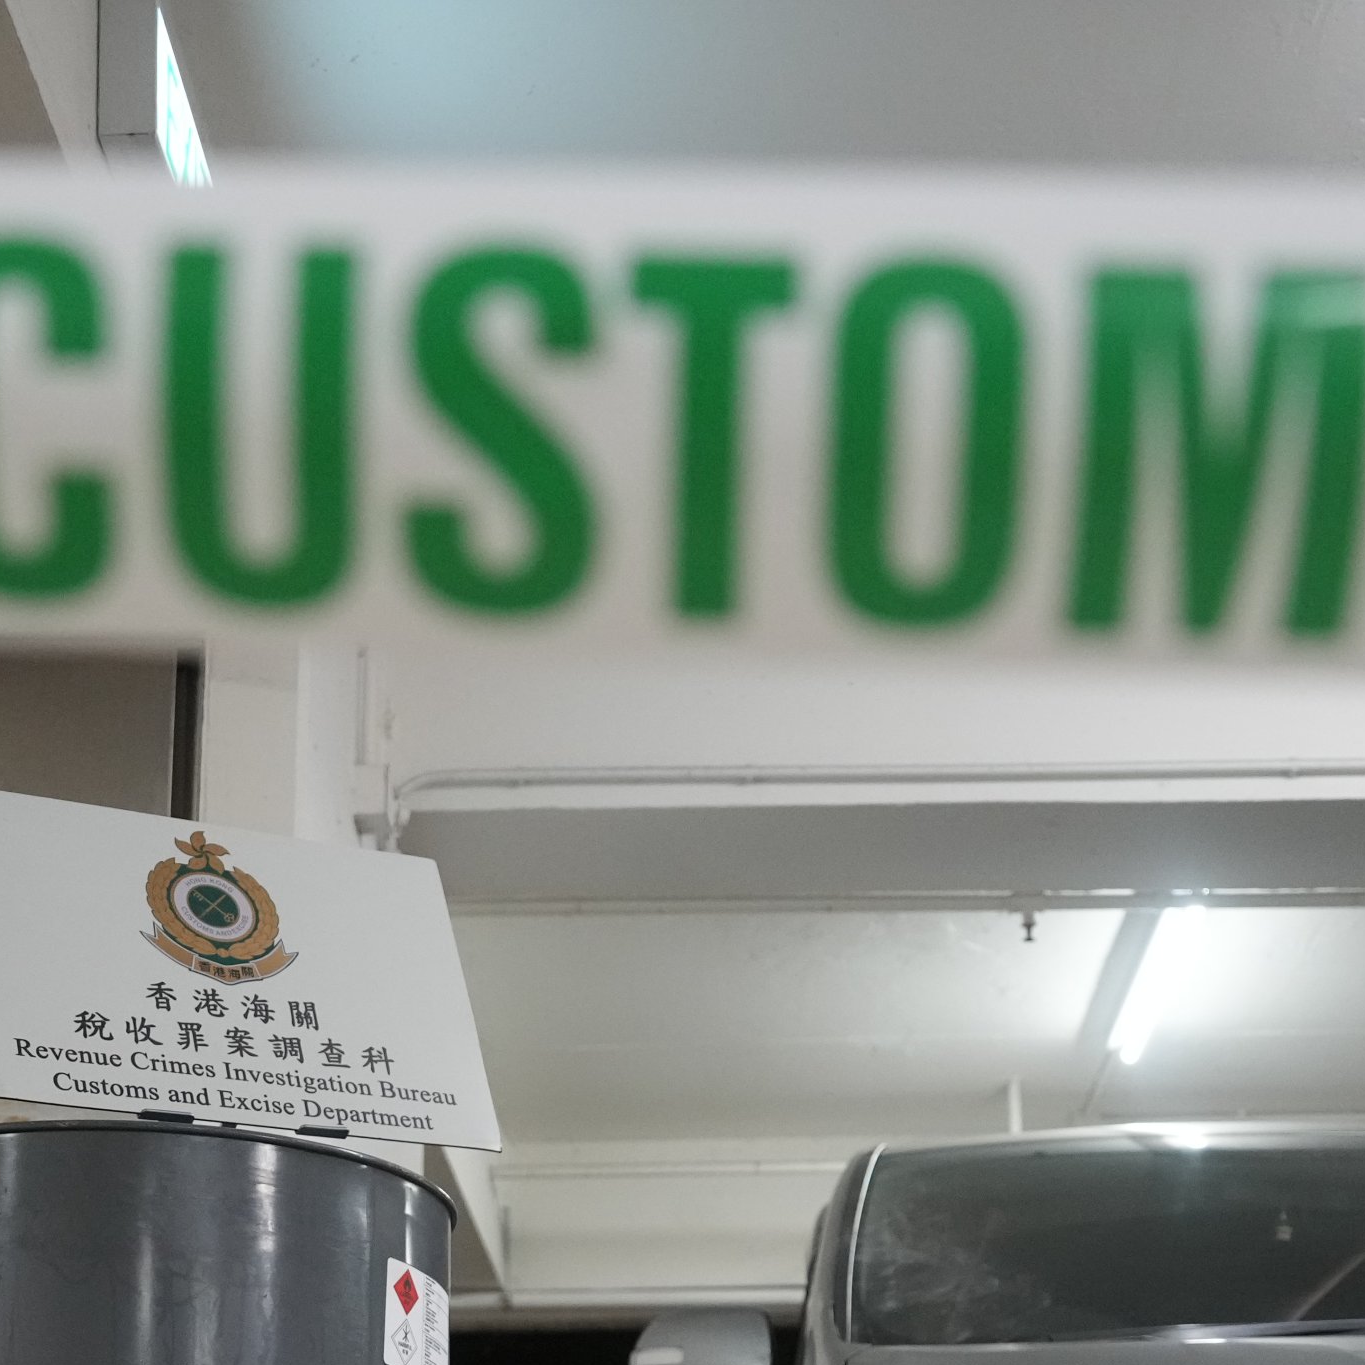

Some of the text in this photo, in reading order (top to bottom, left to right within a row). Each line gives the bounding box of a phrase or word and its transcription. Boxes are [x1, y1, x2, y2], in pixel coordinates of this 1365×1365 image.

[186, 877, 235, 894] HONG KONG
[181, 906, 215, 935] CUSTOMS
[198, 960, 255, 979] 香港海關
[145, 981, 320, 1031] 香港海關
[73, 1010, 395, 1076] 稅收罪案調查科
[13, 1038, 458, 1106] Revenue Crimes Investigation Bureau
[53, 1072, 435, 1131] Customs and Excise Department
